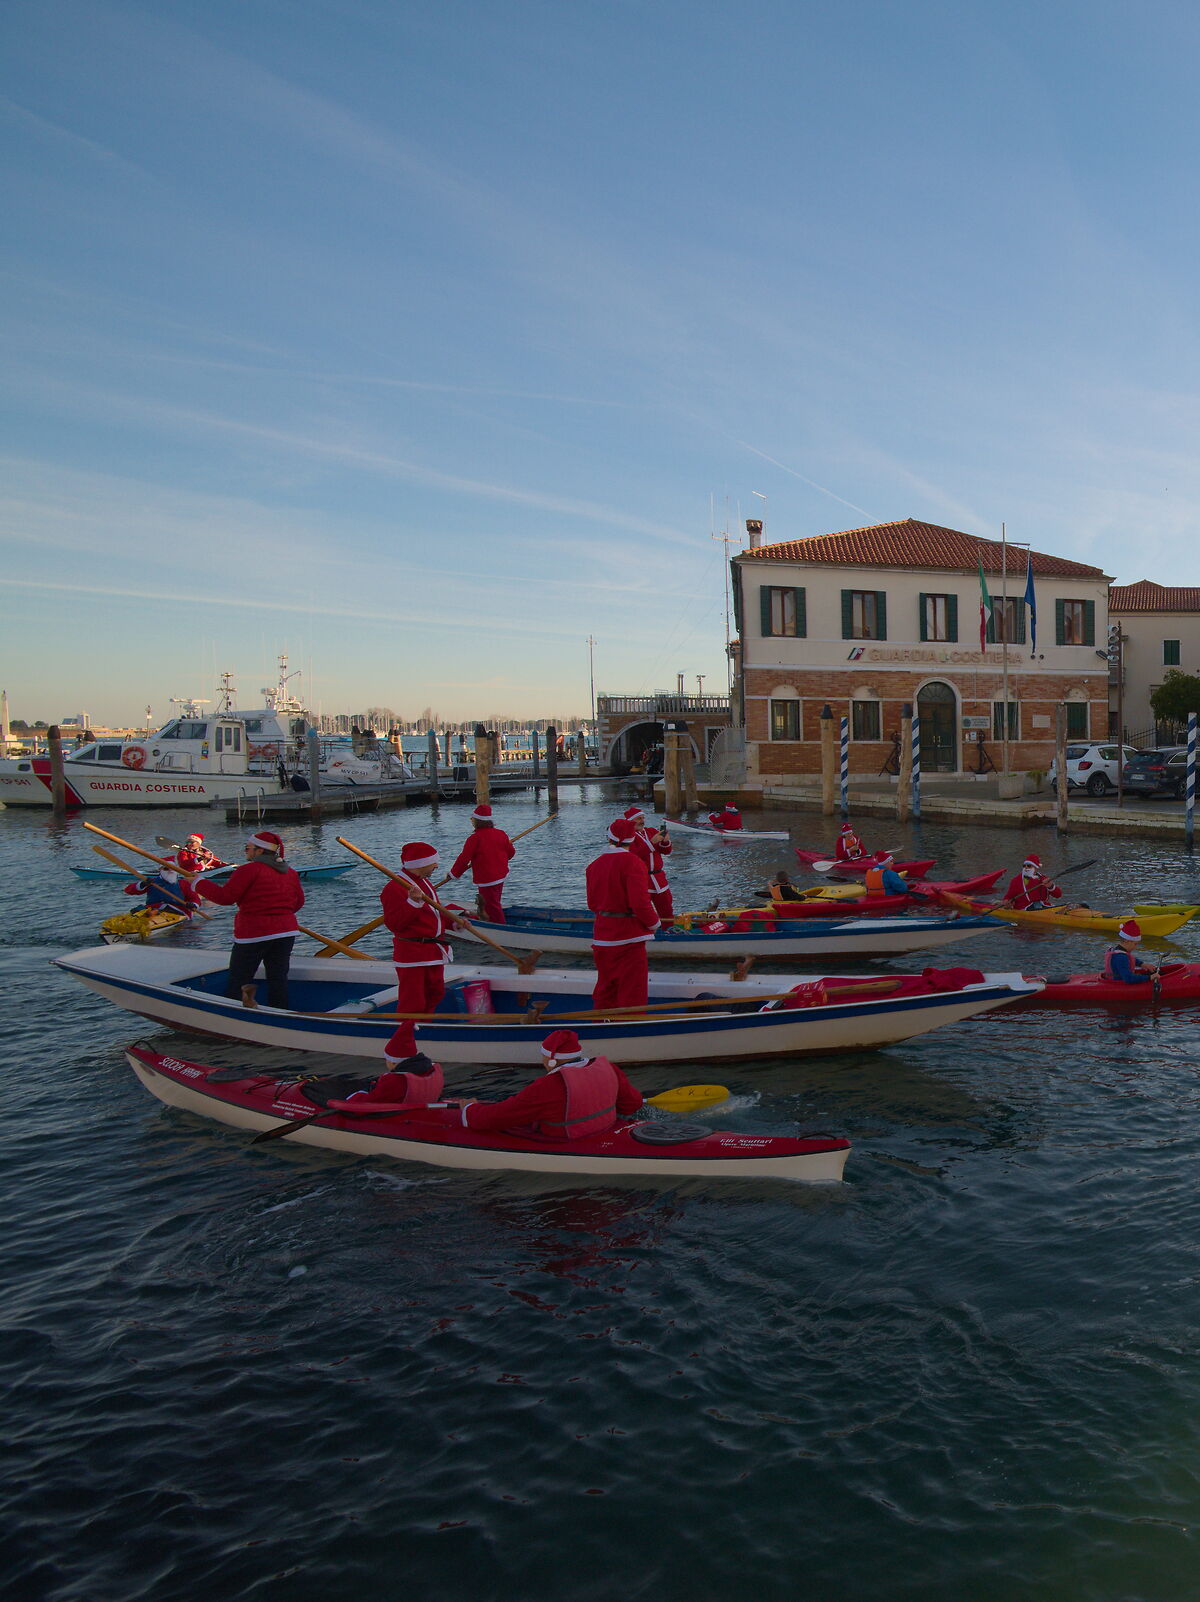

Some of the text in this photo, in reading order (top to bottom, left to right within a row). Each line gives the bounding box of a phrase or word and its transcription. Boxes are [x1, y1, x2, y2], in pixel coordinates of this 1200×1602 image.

[868, 649, 1023, 664] GUARDIA COSTIERA
[90, 781, 206, 793] GUARDIA COSTIERA
